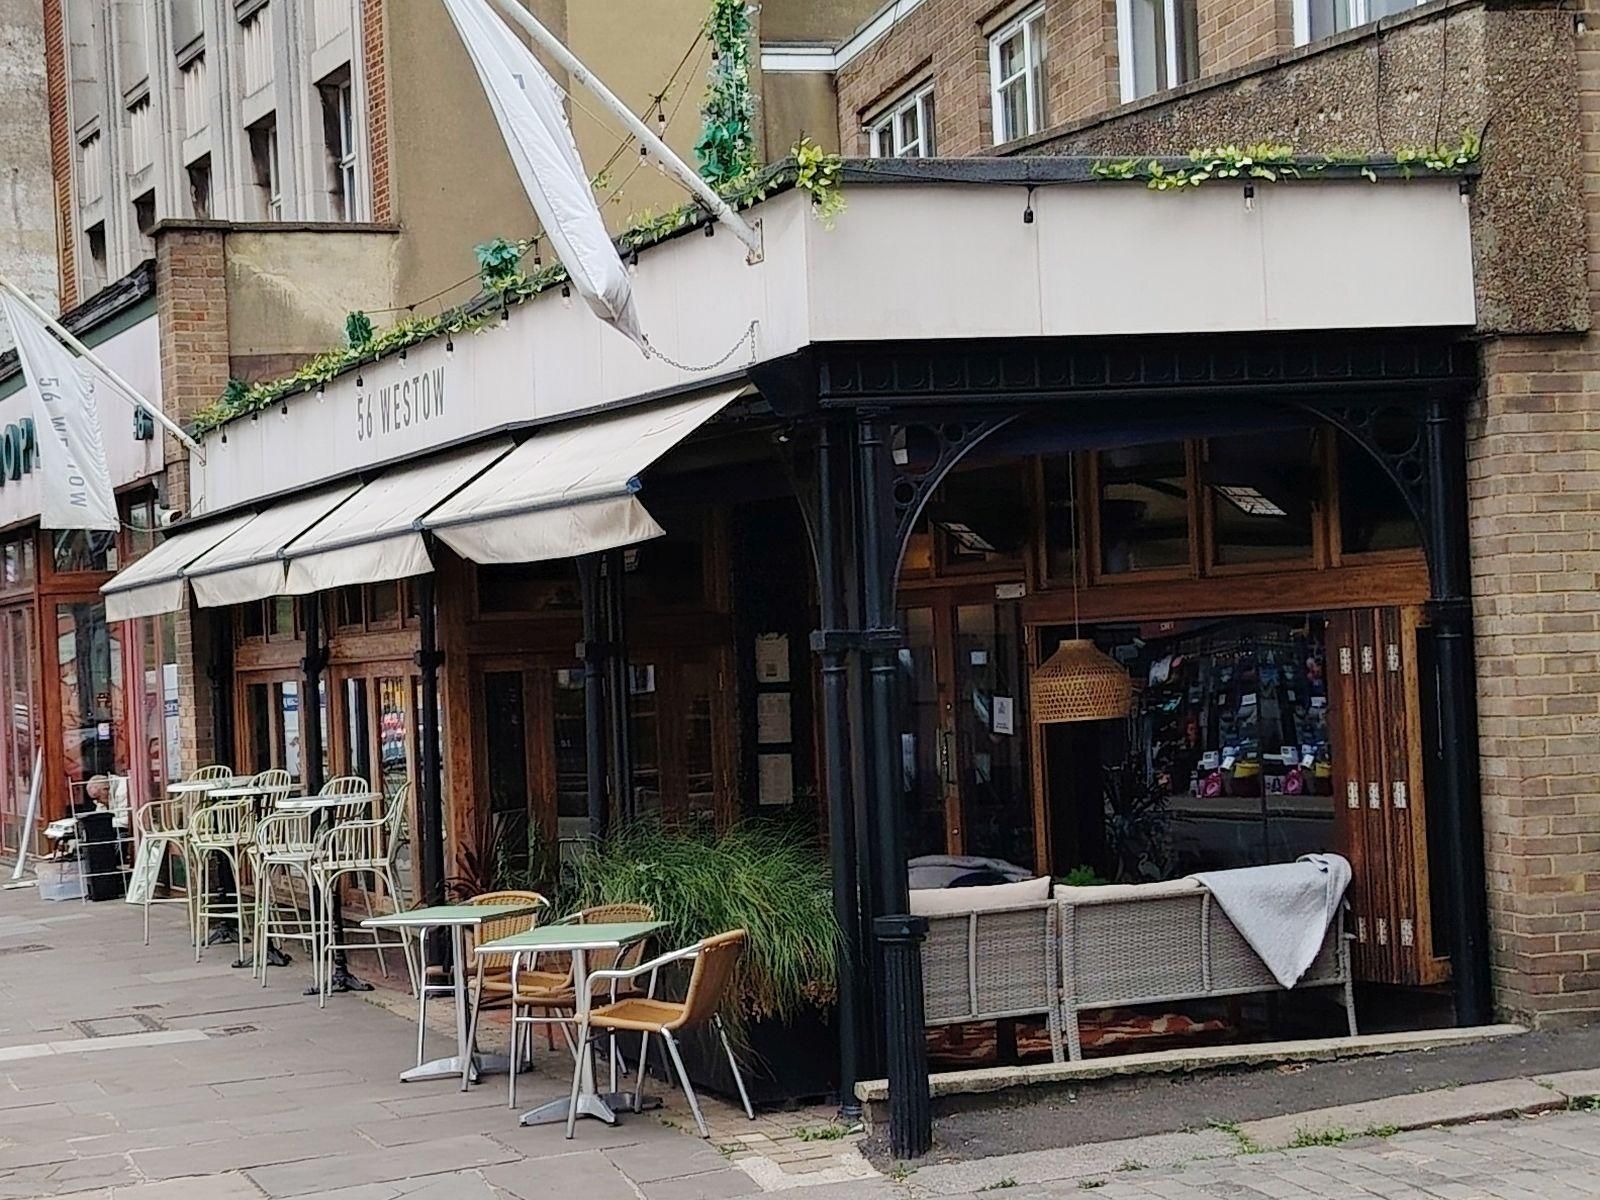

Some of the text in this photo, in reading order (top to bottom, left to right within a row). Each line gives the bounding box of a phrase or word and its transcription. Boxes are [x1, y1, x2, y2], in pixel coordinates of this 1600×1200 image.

[39, 377, 62, 402] 56
[357, 366, 444, 441] 56 WESTOW
